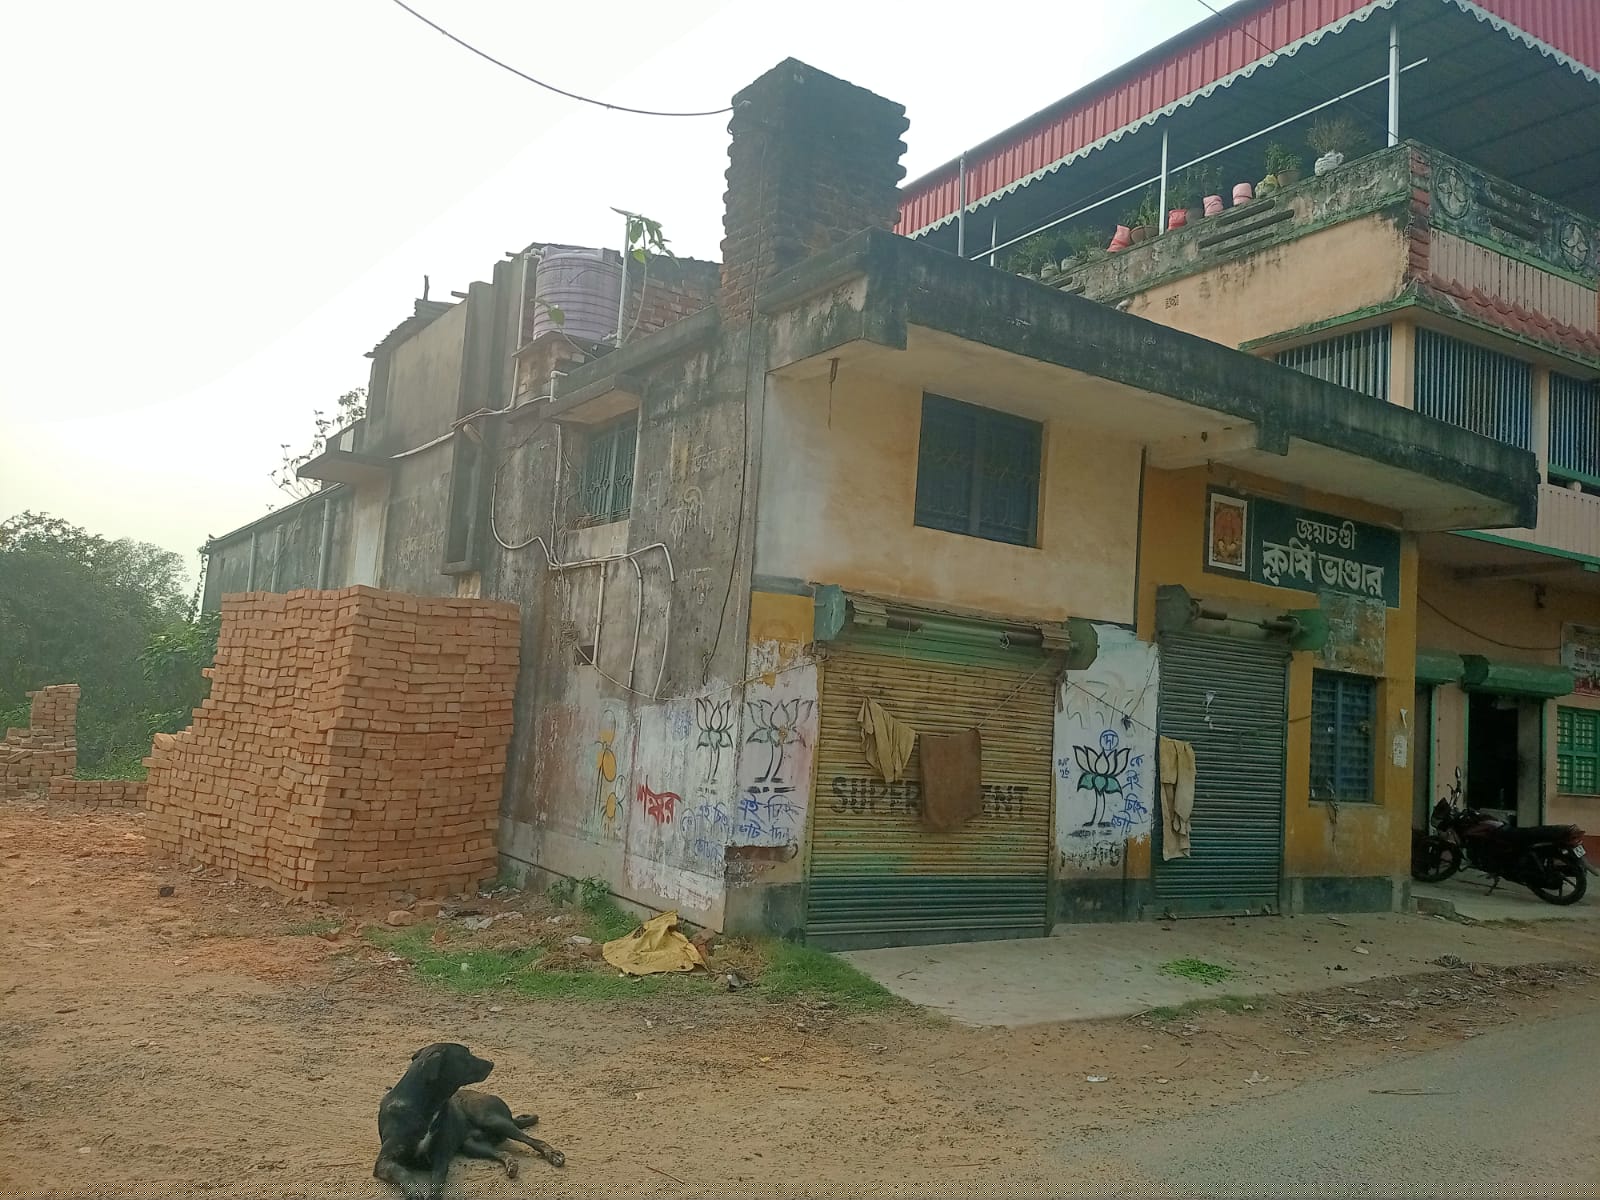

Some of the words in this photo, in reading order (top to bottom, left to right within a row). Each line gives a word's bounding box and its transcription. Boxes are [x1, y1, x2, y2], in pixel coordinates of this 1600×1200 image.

[1295, 518, 1357, 550] জয়চণ্ডী
[1262, 538, 1316, 585] কৃষি
[1318, 554, 1385, 597] ভাণ্ডার
